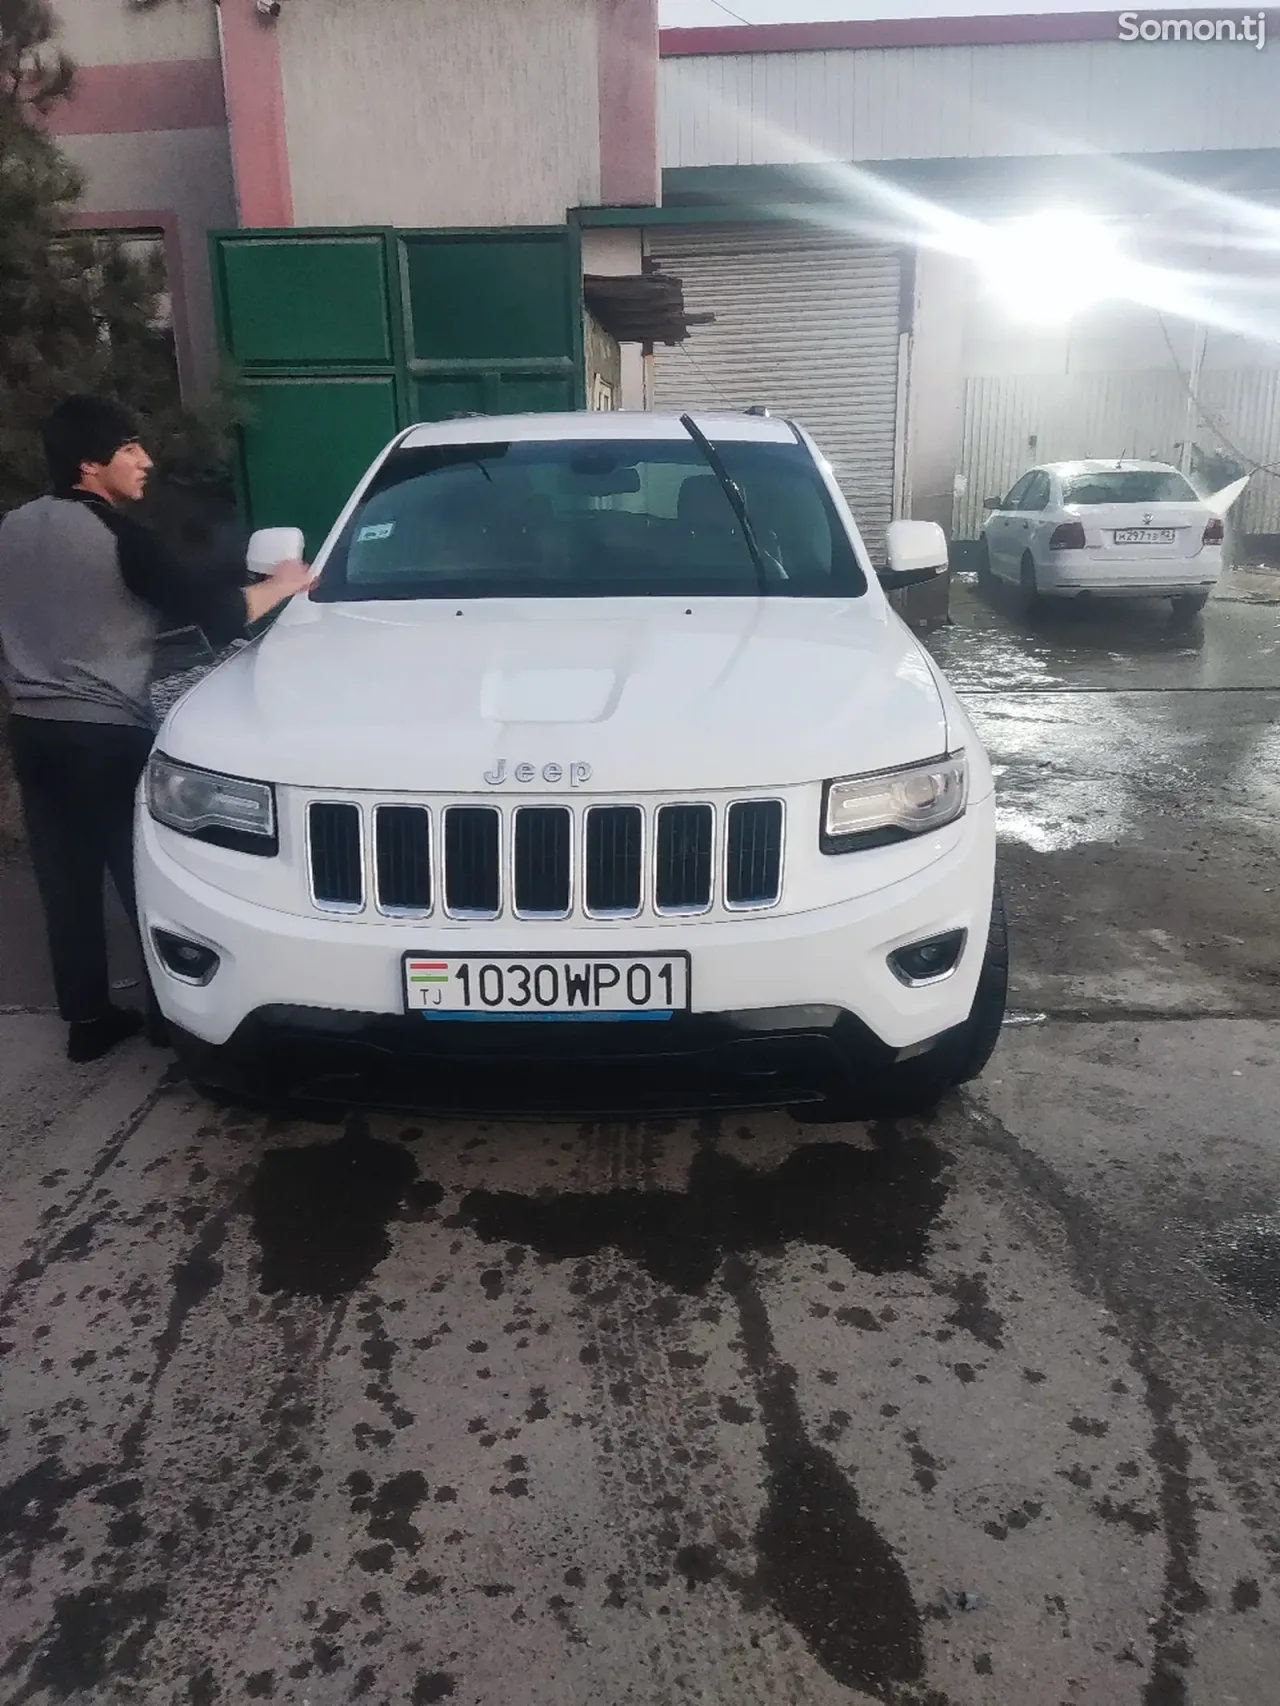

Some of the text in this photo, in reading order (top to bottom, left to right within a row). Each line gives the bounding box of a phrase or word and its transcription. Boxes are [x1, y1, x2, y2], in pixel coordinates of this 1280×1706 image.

[484, 758, 593, 787] Jeep
[420, 988, 442, 1005] TJ
[455, 963, 672, 1007] 1030WP01
